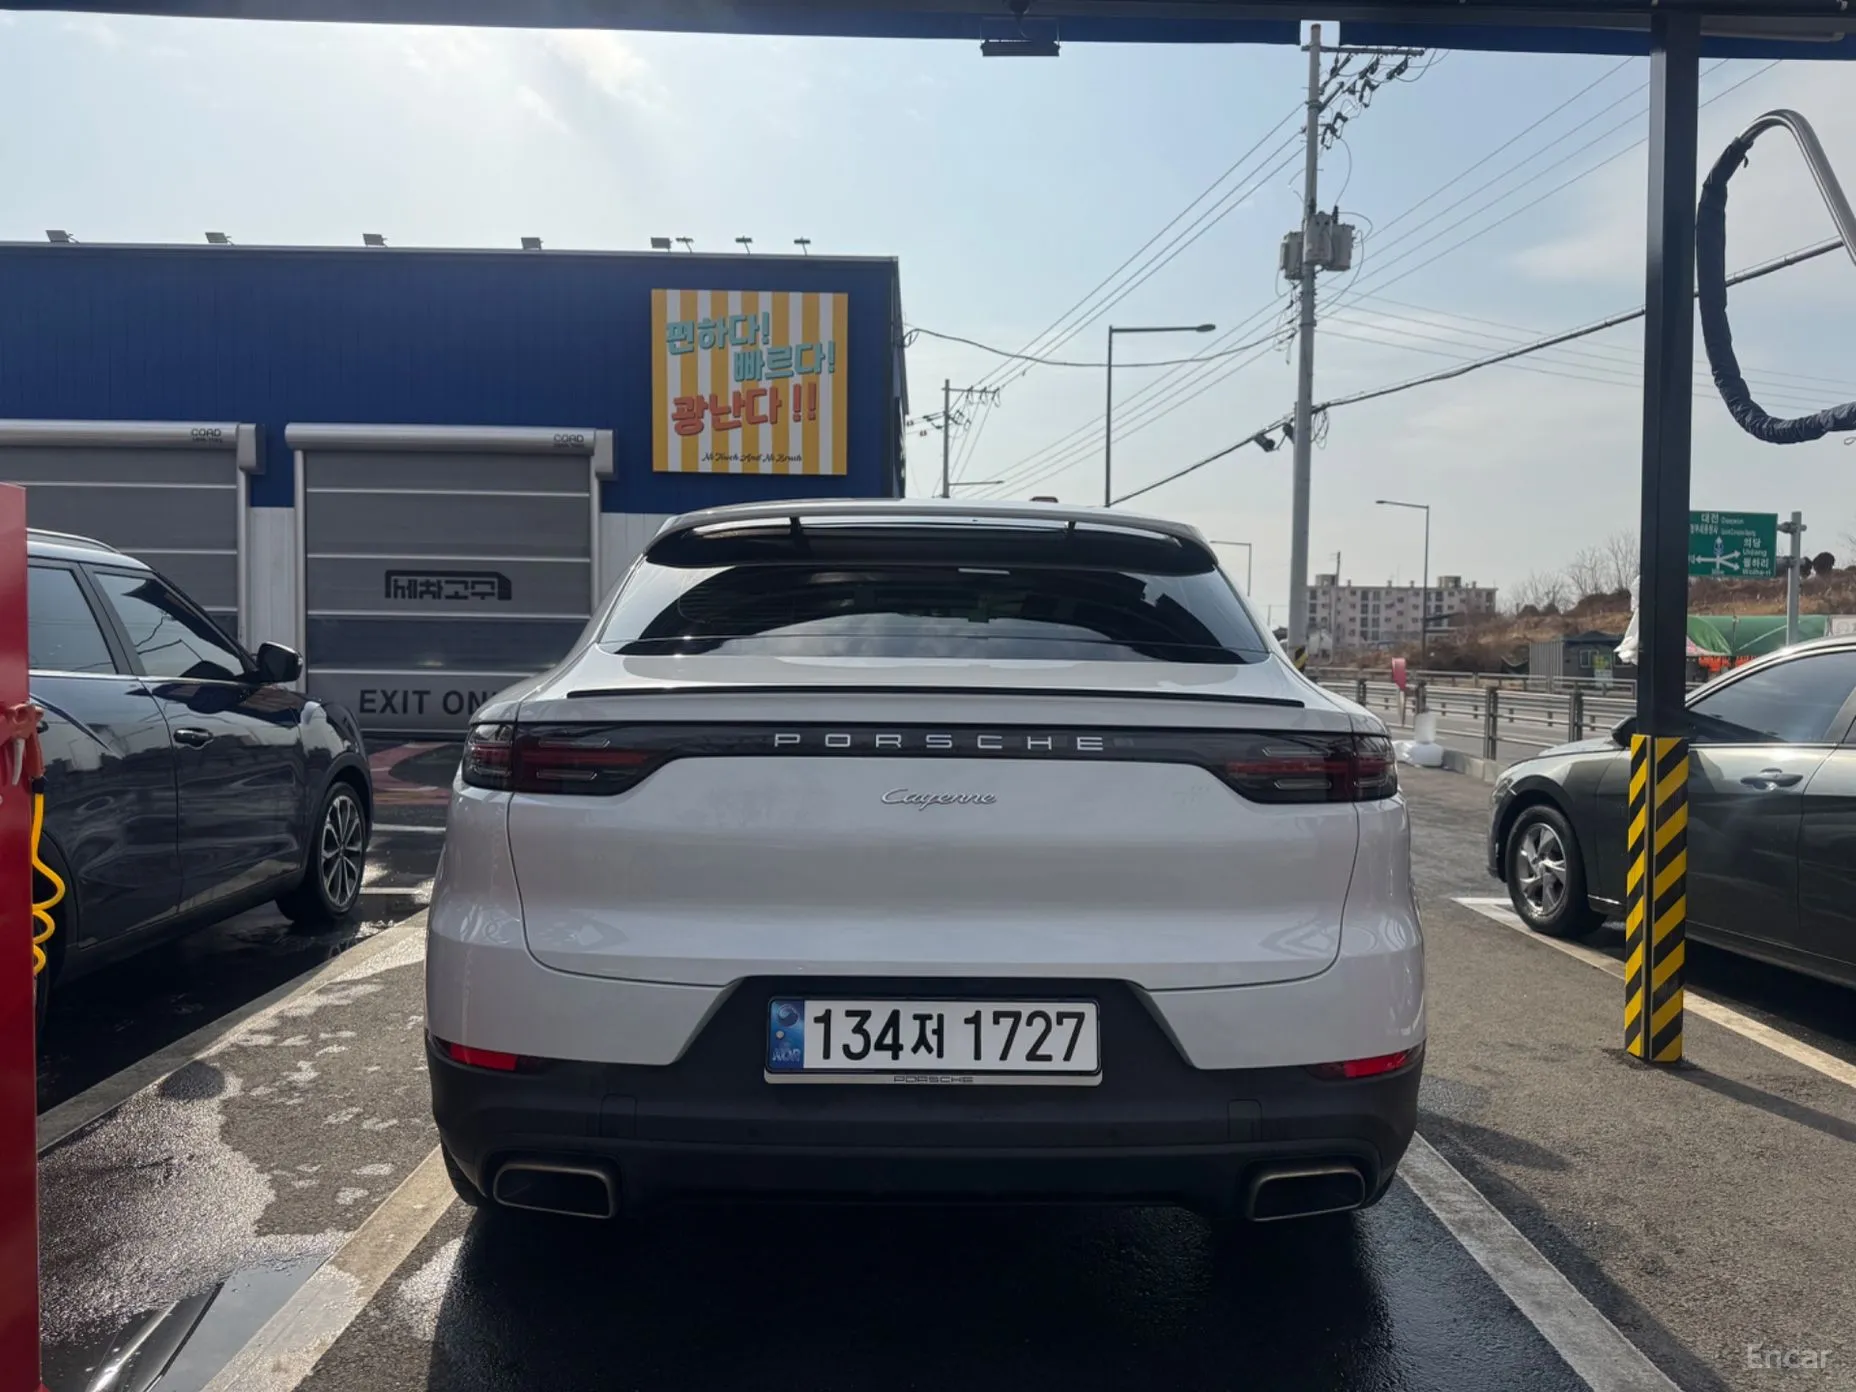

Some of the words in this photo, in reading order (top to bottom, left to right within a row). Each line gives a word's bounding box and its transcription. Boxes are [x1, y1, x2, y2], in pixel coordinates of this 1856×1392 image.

[666, 312, 770, 355] 편하다!
[734, 341, 836, 382] 빠르다!
[359, 689, 431, 714] EXIT
[774, 733, 1104, 751] PORSCHE
[881, 788, 998, 812] Cayenne
[813, 1008, 945, 1062] 134저
[963, 1009, 1086, 1062] 1727
[894, 1075, 974, 1083] PORSCHE
